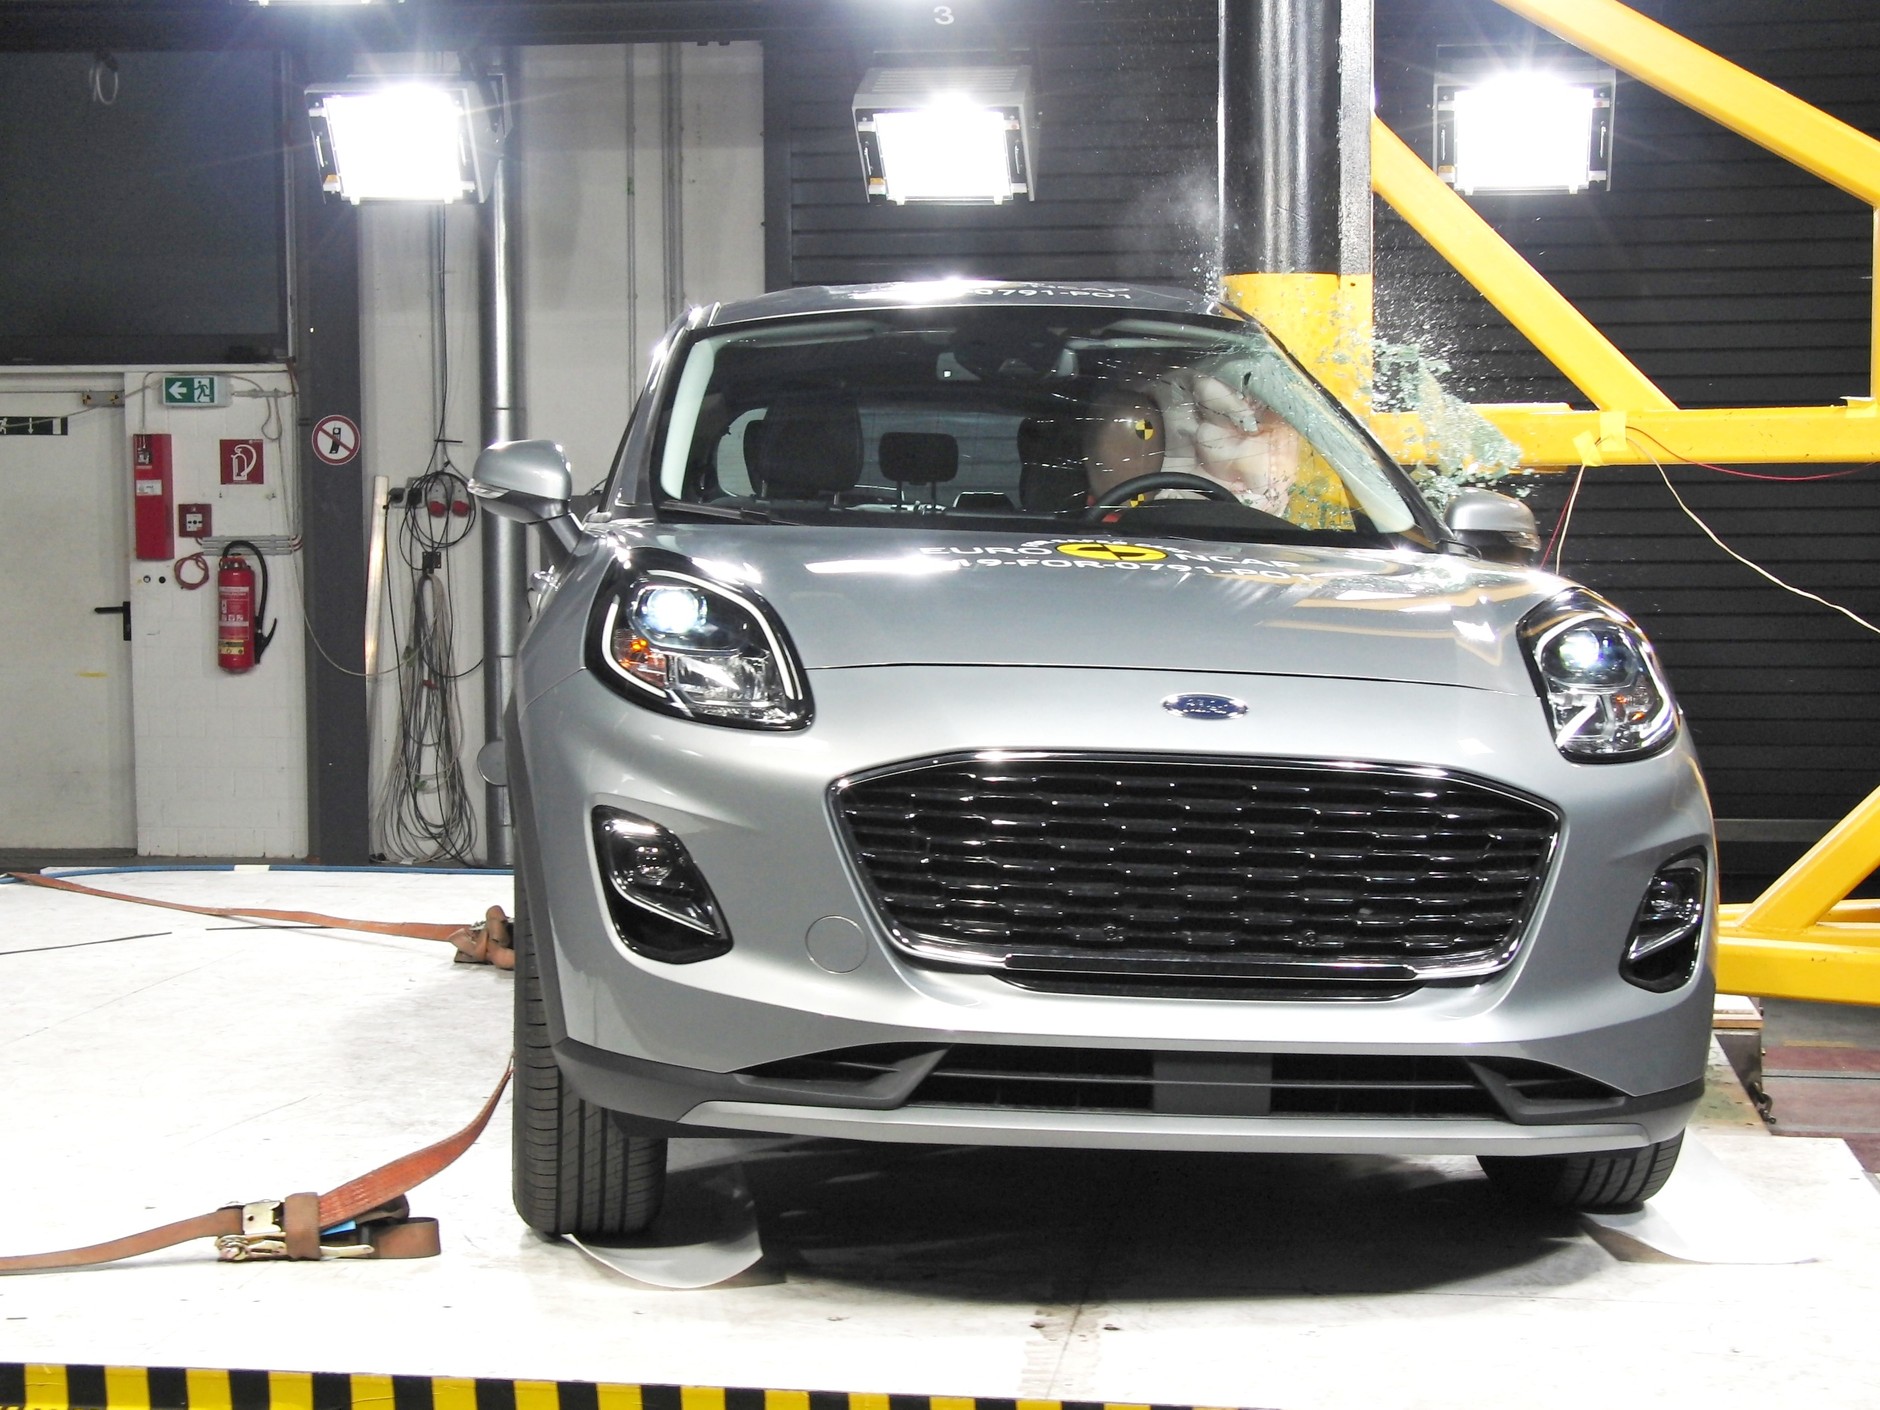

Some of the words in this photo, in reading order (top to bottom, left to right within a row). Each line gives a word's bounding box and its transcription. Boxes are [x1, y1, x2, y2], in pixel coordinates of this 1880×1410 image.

[933, 5, 955, 25] 3
[919, 546, 1054, 555] EURO
[1174, 553, 1301, 568] NCAP
